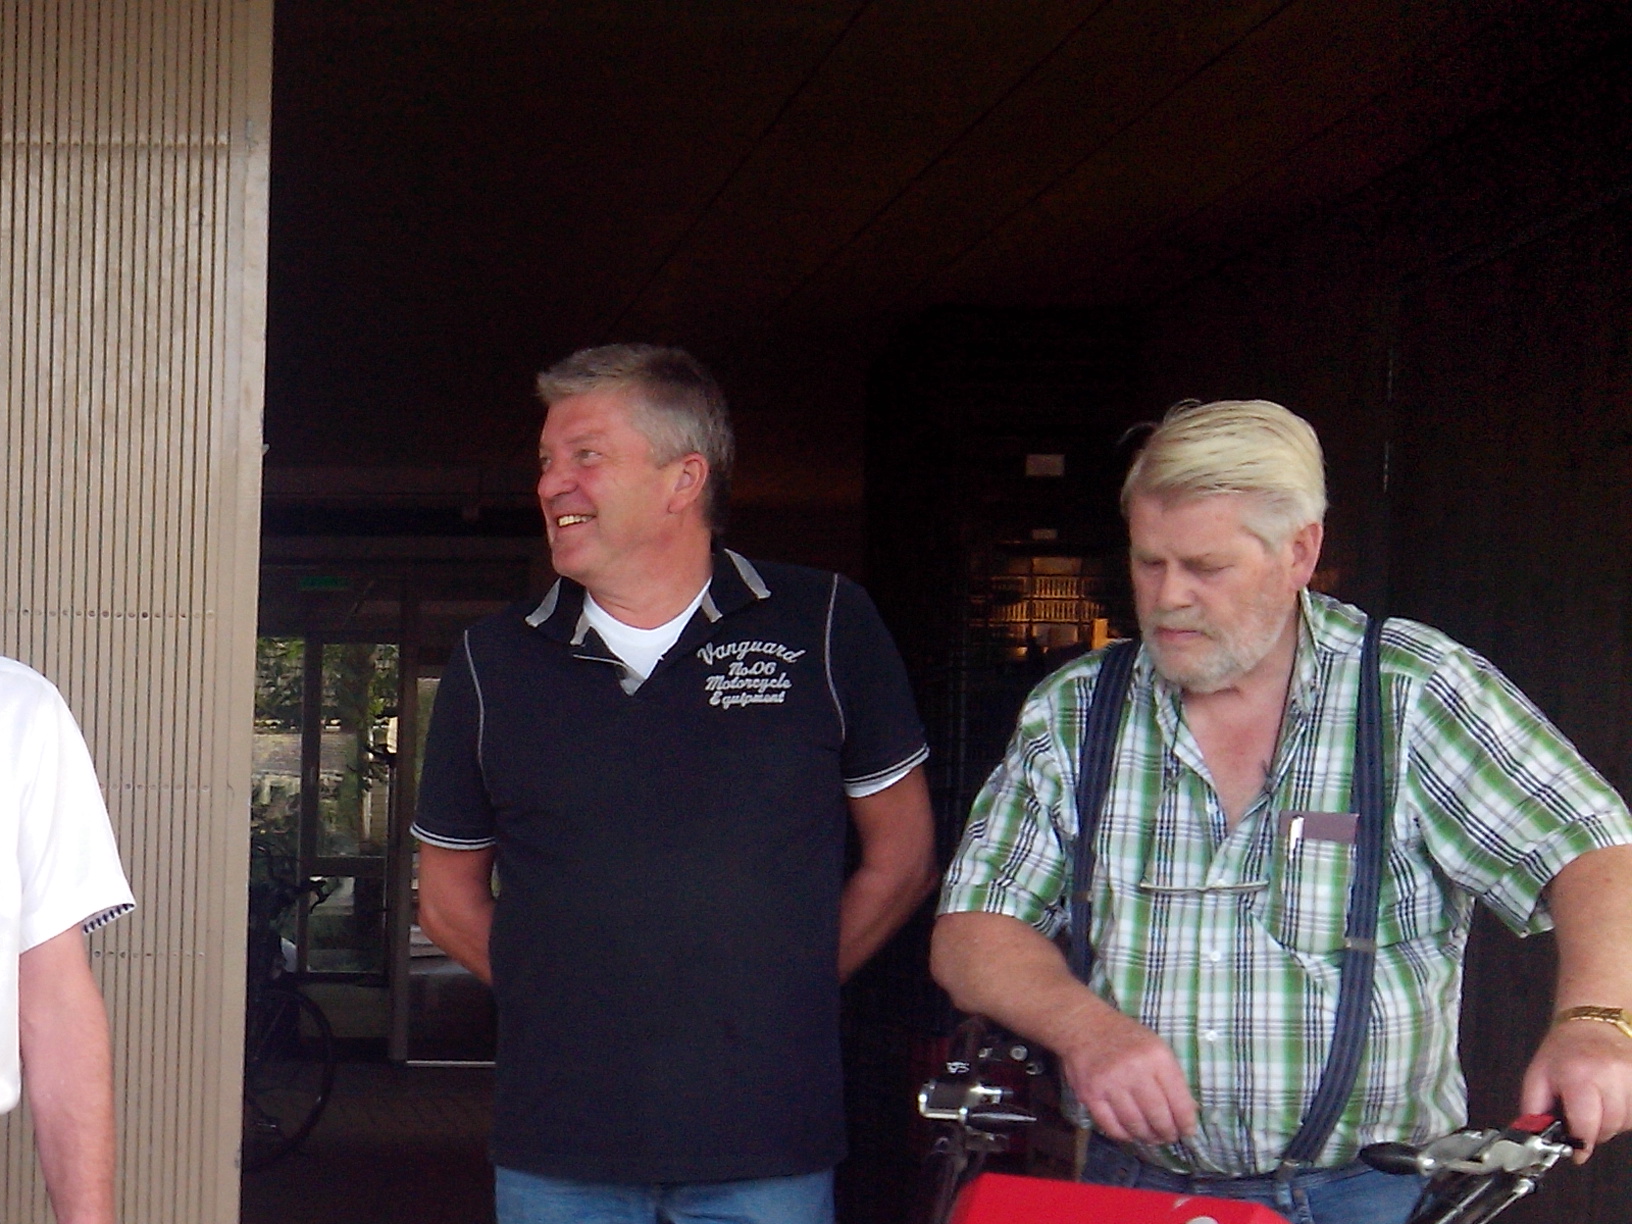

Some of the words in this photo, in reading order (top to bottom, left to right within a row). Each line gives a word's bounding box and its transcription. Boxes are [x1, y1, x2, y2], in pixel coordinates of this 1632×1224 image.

[697, 640, 806, 665] Vanguard
[704, 672, 793, 692] Motorcycle
[709, 691, 786, 709] Equipment
